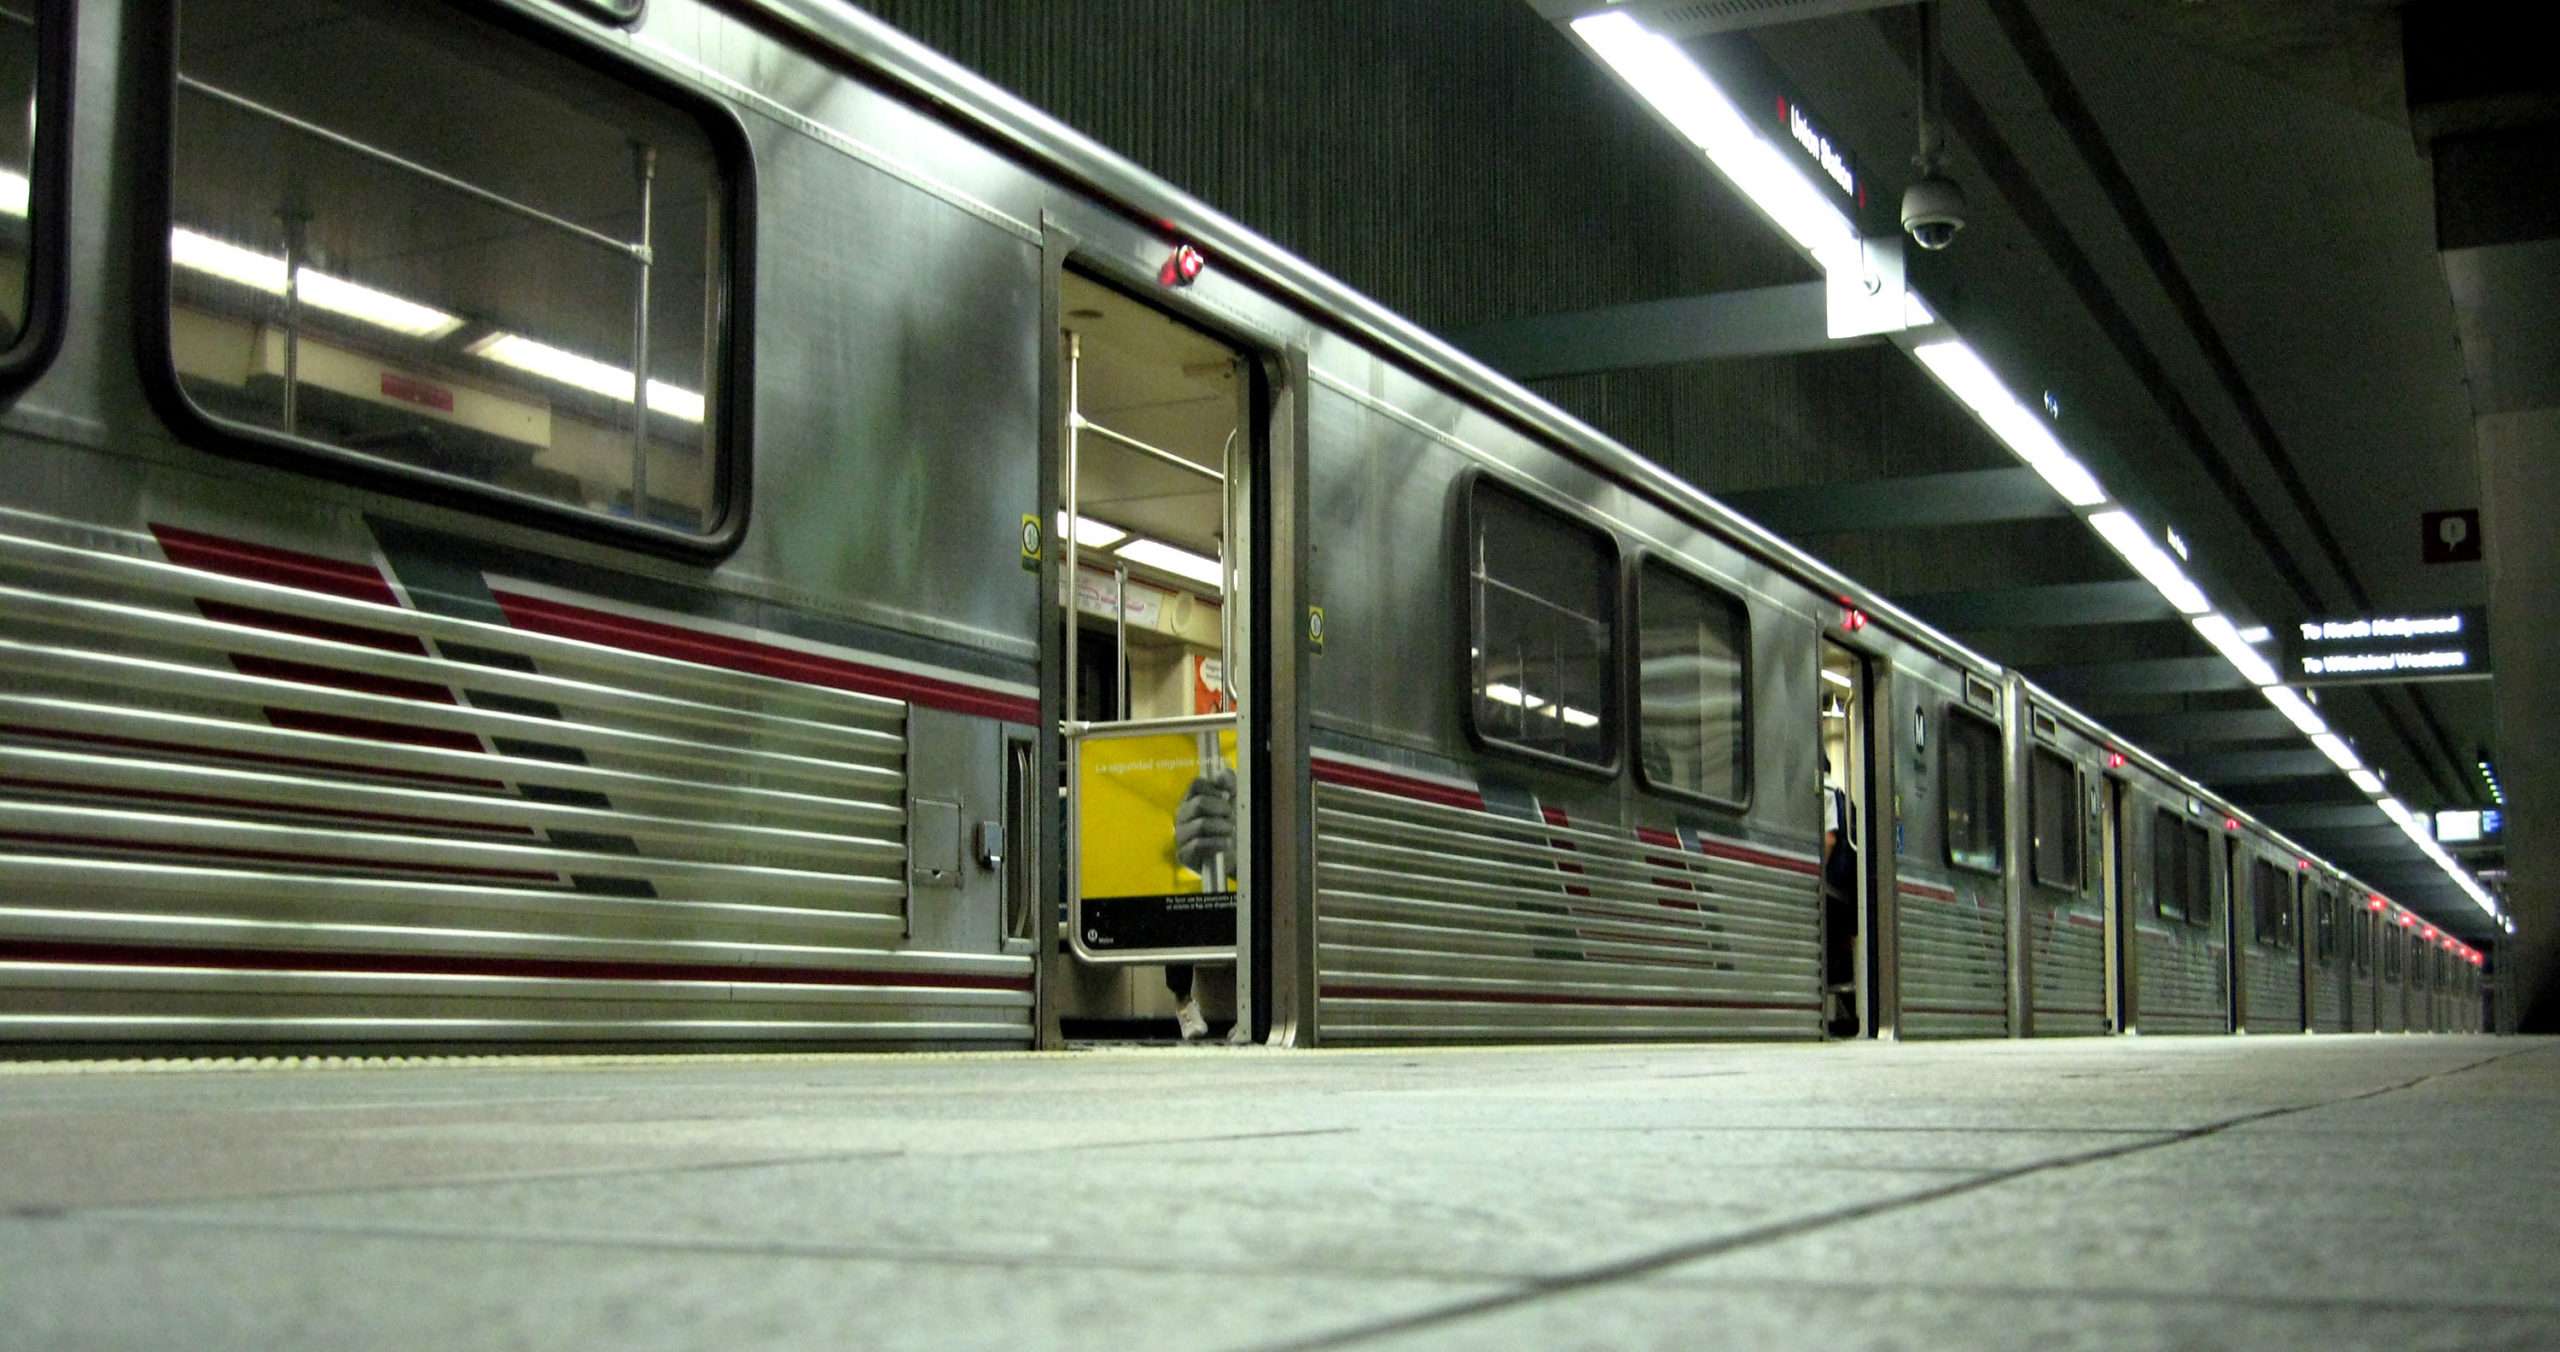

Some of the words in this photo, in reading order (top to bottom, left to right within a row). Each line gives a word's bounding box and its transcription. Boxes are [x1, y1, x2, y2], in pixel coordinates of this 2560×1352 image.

[1791, 104, 1820, 161] Union
[1820, 137, 1853, 197] Station
[2300, 622, 2323, 640] To
[2323, 620, 2371, 638] North
[2372, 614, 2461, 637] Hollywood
[2302, 657, 2323, 673] To
[1109, 759, 1153, 775] seguridad
